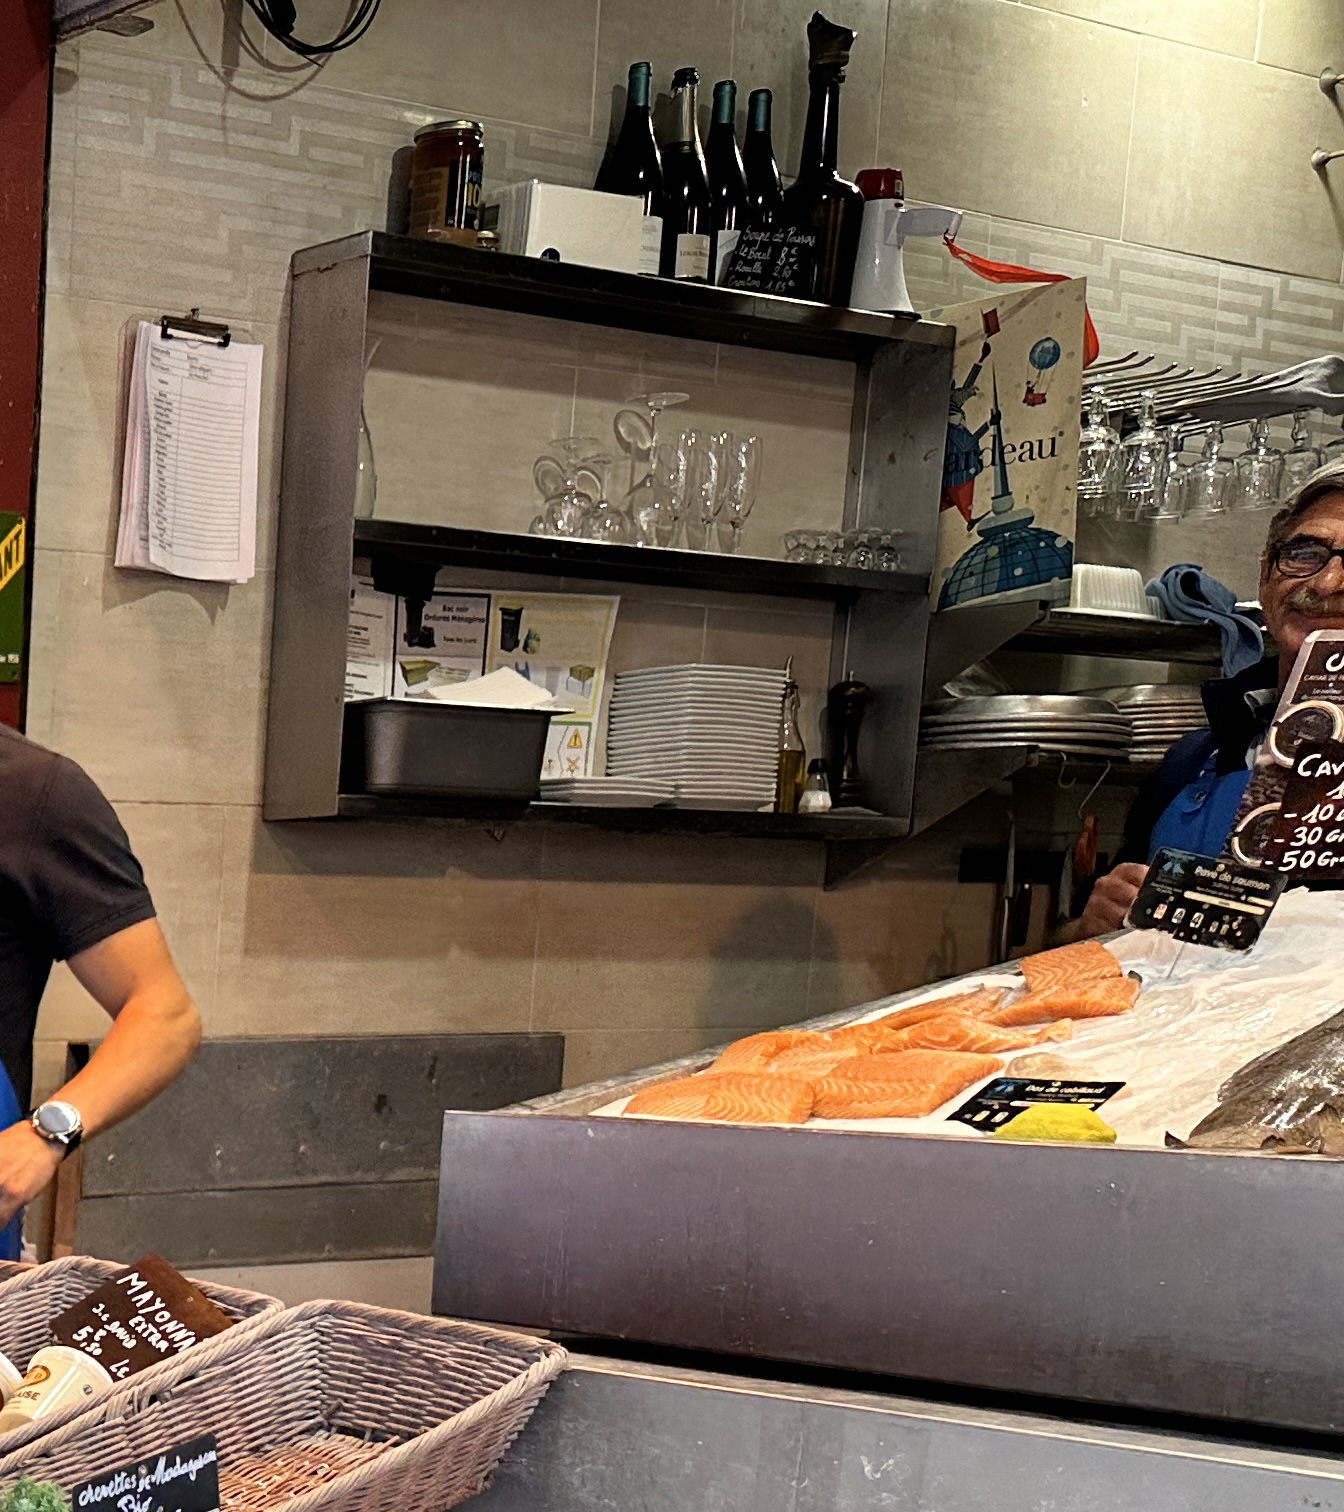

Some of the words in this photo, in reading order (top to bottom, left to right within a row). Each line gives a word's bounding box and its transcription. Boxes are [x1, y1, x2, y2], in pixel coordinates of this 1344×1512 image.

[946, 435, 1058, 473] ardeau
[1297, 754, 1344, 778] CAV
[1290, 827, 1322, 847] 30
[1278, 850, 1316, 872] 50
[116, 1272, 197, 1353] MAYONNA
[128, 1315, 170, 1353] EXTRA
